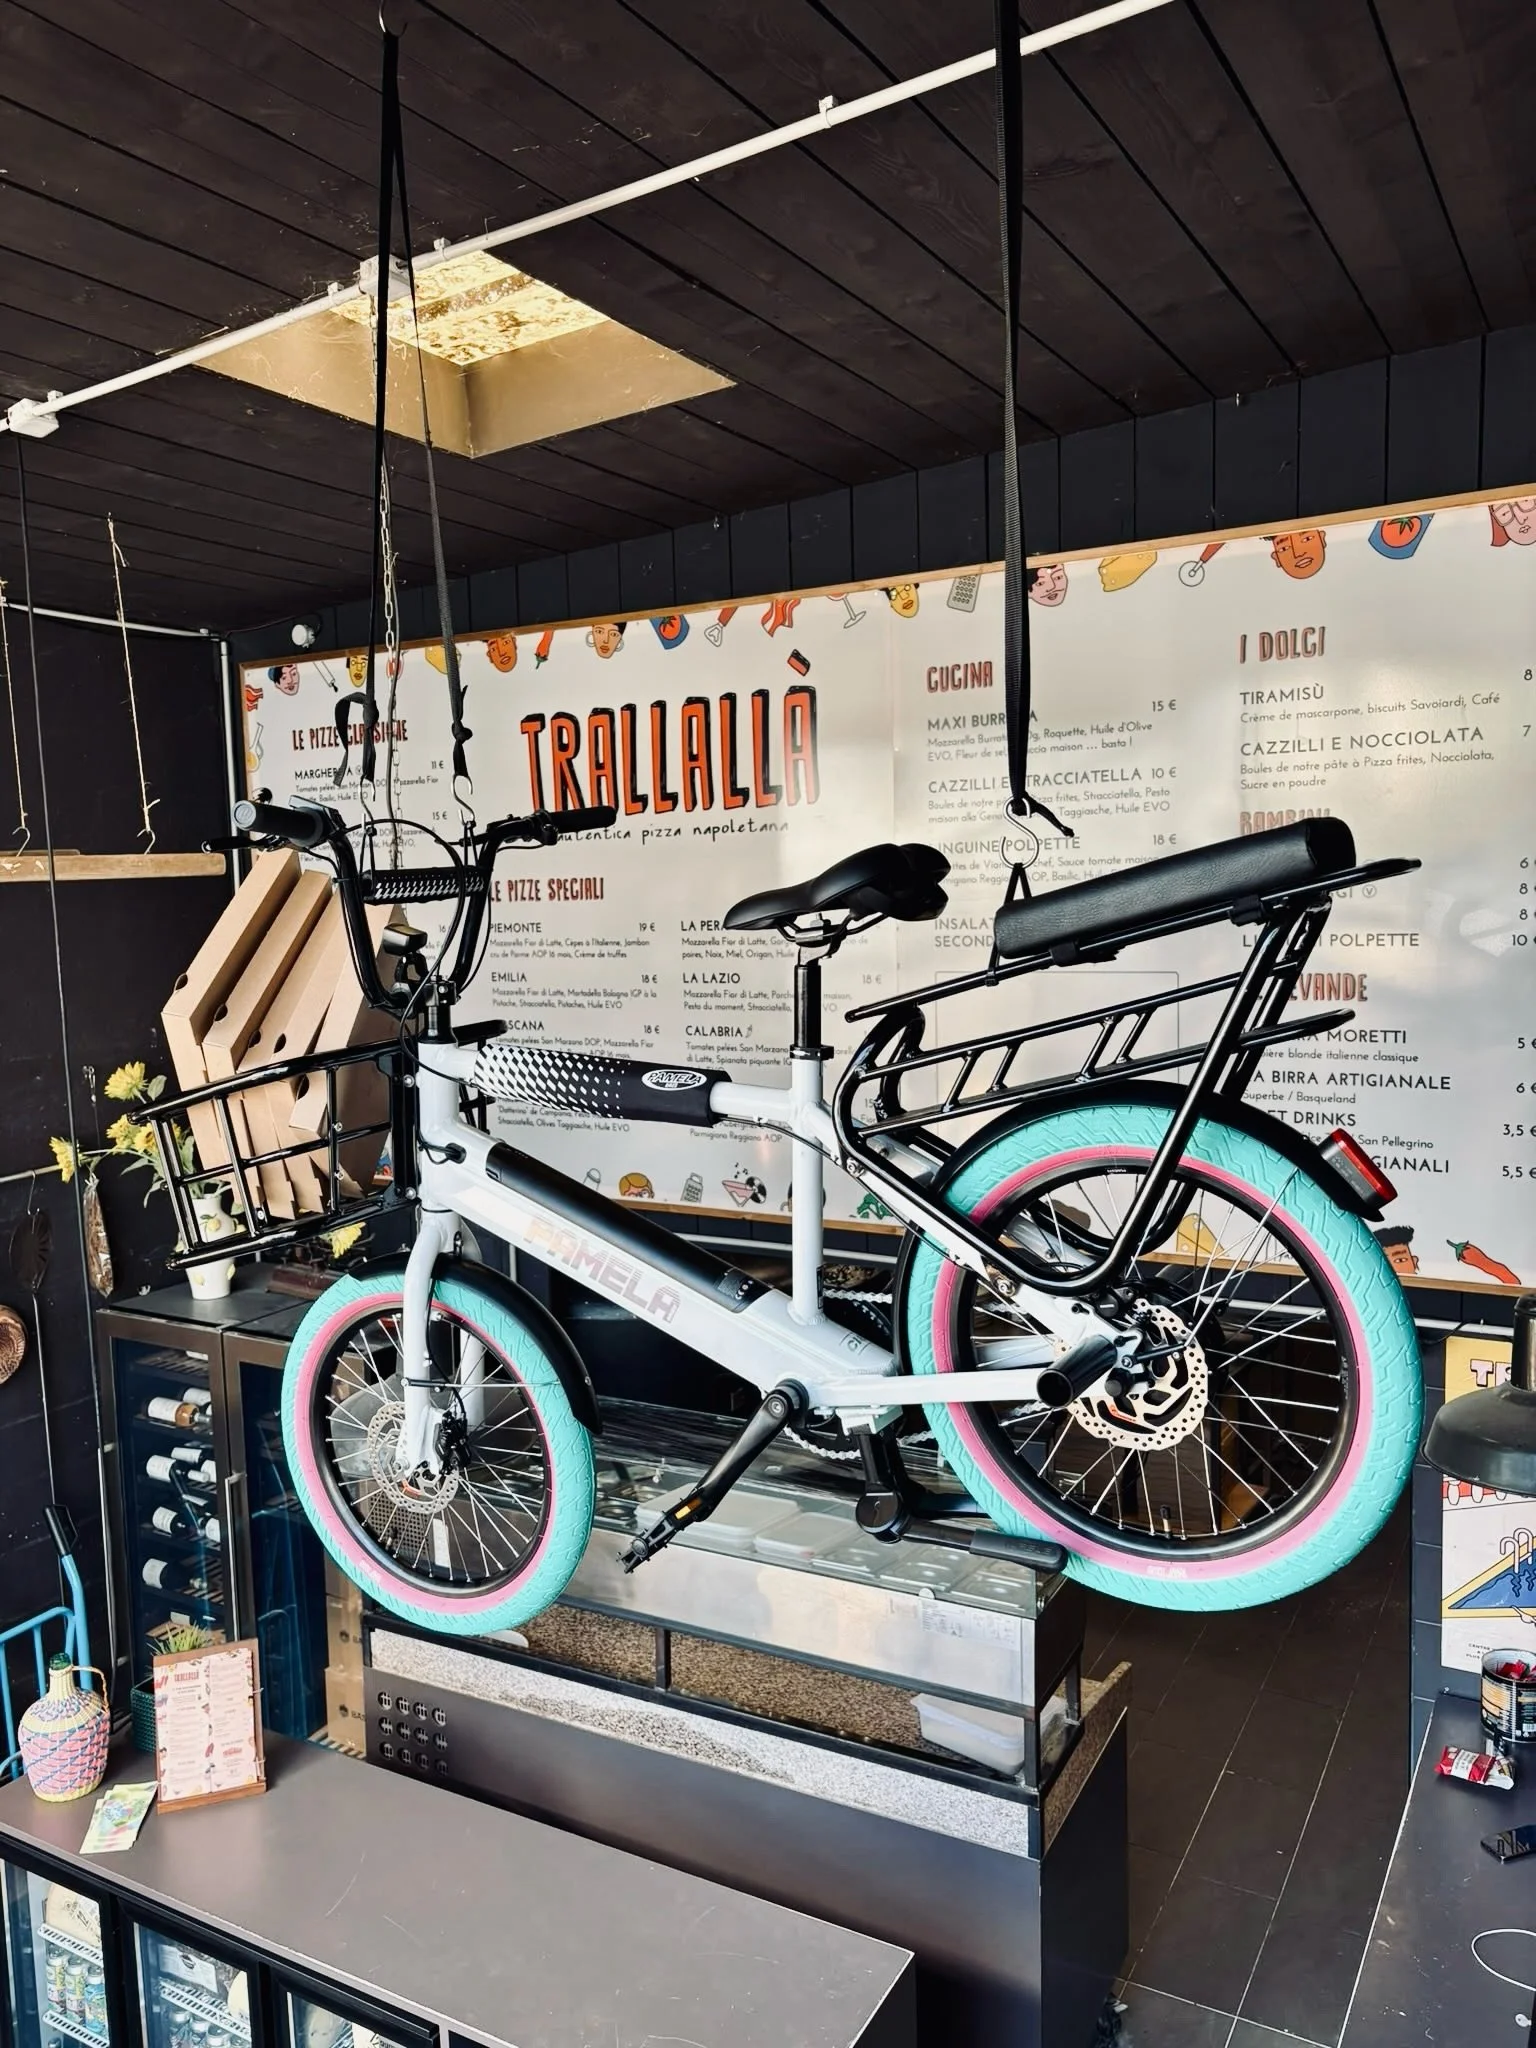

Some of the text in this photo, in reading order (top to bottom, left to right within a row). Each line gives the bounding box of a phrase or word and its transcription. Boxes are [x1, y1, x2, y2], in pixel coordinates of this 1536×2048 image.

[1240, 626, 1326, 664] I DOLCI
[927, 661, 993, 693] CUCINA
[1523, 668, 1533, 681] 8
[1240, 683, 1324, 705] TIRAMISÙ
[1152, 699, 1176, 712] 15 €
[1240, 691, 1500, 723] Crème de mascarpone, biscuits Savoiardi, Café
[927, 710, 1038, 731] MAXI BURRA
[521, 649, 821, 816] TRALLALLÀ
[1043, 727, 1087, 740] Roquette,
[1090, 723, 1114, 735] Huile
[1117, 721, 1153, 733] d'Olive
[292, 729, 304, 750] LE
[310, 726, 339, 750] PIZZE
[927, 734, 975, 748] Mozzarella
[1240, 725, 1531, 756] CAZZILLI E NOCCIOLATA 7
[1050, 744, 1083, 753] maison
[1101, 738, 1127, 749] basta
[955, 749, 978, 760] Fleur
[981, 748, 992, 758] de
[1240, 749, 1495, 775] Boules de notre pâte à Pizza frites, Nocciolata,
[1152, 767, 1177, 779] 10 €
[928, 768, 1142, 794] CAZZILLI E TRACCIATELLA
[1240, 775, 1327, 790] Sucre en poudre
[1055, 791, 1081, 802] frites,
[1083, 788, 1142, 801] Stracciatella,
[1145, 787, 1170, 798] Pesto
[928, 799, 955, 810] Boules
[957, 798, 968, 808] de
[971, 798, 994, 808] notre
[1058, 800, 1170, 819] Taggiasche, Huile EVO
[432, 811, 440, 820] 15
[928, 814, 959, 824] maison
[642, 823, 681, 845] pizza
[693, 818, 789, 842] napoletana
[1153, 833, 1177, 846] 18 €
[938, 839, 1000, 854] INGUINE
[969, 860, 980, 869] de
[1058, 856, 1121, 867] Sauce tomate
[1520, 857, 1529, 869] 6
[491, 877, 605, 902] LE PIZZE SPECIALI
[1519, 882, 1528, 895] 8
[1519, 908, 1528, 920] 8
[490, 922, 542, 933] PIEMONTE
[639, 922, 656, 932] 19 €
[680, 920, 723, 932] LA PER
[934, 917, 994, 930] INSALA
[681, 936, 720, 946] Mozzarella
[722, 936, 736, 946] Fior
[738, 936, 745, 946] di
[747, 937, 768, 946] Latte,
[934, 934, 994, 947] SECOND
[1330, 933, 1420, 947] POLPETTE
[1512, 934, 1528, 946] 10
[597, 950, 605, 958] de
[746, 949, 774, 960] Origan,
[491, 972, 527, 983] EMILIA
[641, 974, 658, 984] 18 €
[683, 972, 741, 984] LA LAZIO
[862, 974, 882, 985] 18 €
[1290, 972, 1368, 1002] VANDE
[683, 990, 722, 999] Mozzarella
[723, 989, 737, 999] Fior
[740, 990, 746, 999] di
[605, 1001, 623, 1009] EVO
[683, 1001, 701, 1010] Pesto
[703, 1001, 712, 1010] du
[714, 1002, 746, 1012] moment,
[504, 1020, 544, 1031] SCANA
[643, 1024, 660, 1034] 18 €
[685, 1025, 743, 1038] CALABRIA
[1327, 1029, 1407, 1044] MORETTI
[1517, 1037, 1525, 1049] 5
[686, 1041, 715, 1051] Tomates
[740, 1043, 753, 1052] San
[756, 1044, 789, 1053] Marzano
[686, 1053, 693, 1062] di
[716, 1055, 748, 1066] Spianata
[749, 1057, 781, 1068] piquante
[1288, 1048, 1419, 1064] blonde italienne classique
[1272, 1070, 1451, 1090] BIRRA ARTIGIANALE
[1516, 1082, 1525, 1094] 6
[1243, 1089, 1356, 1105] Superbe Basqueland
[1294, 1111, 1356, 1127] DRINKS
[612, 1123, 630, 1132] EVO
[1502, 1123, 1524, 1138] 3,5
[764, 1133, 783, 1143] AOP
[1358, 1134, 1379, 1146] San
[1382, 1135, 1434, 1150] Pellegrino
[1371, 1155, 1450, 1174] GIANALI
[1502, 1165, 1523, 1179] 5,5
[1470, 1358, 1512, 1387] TR
